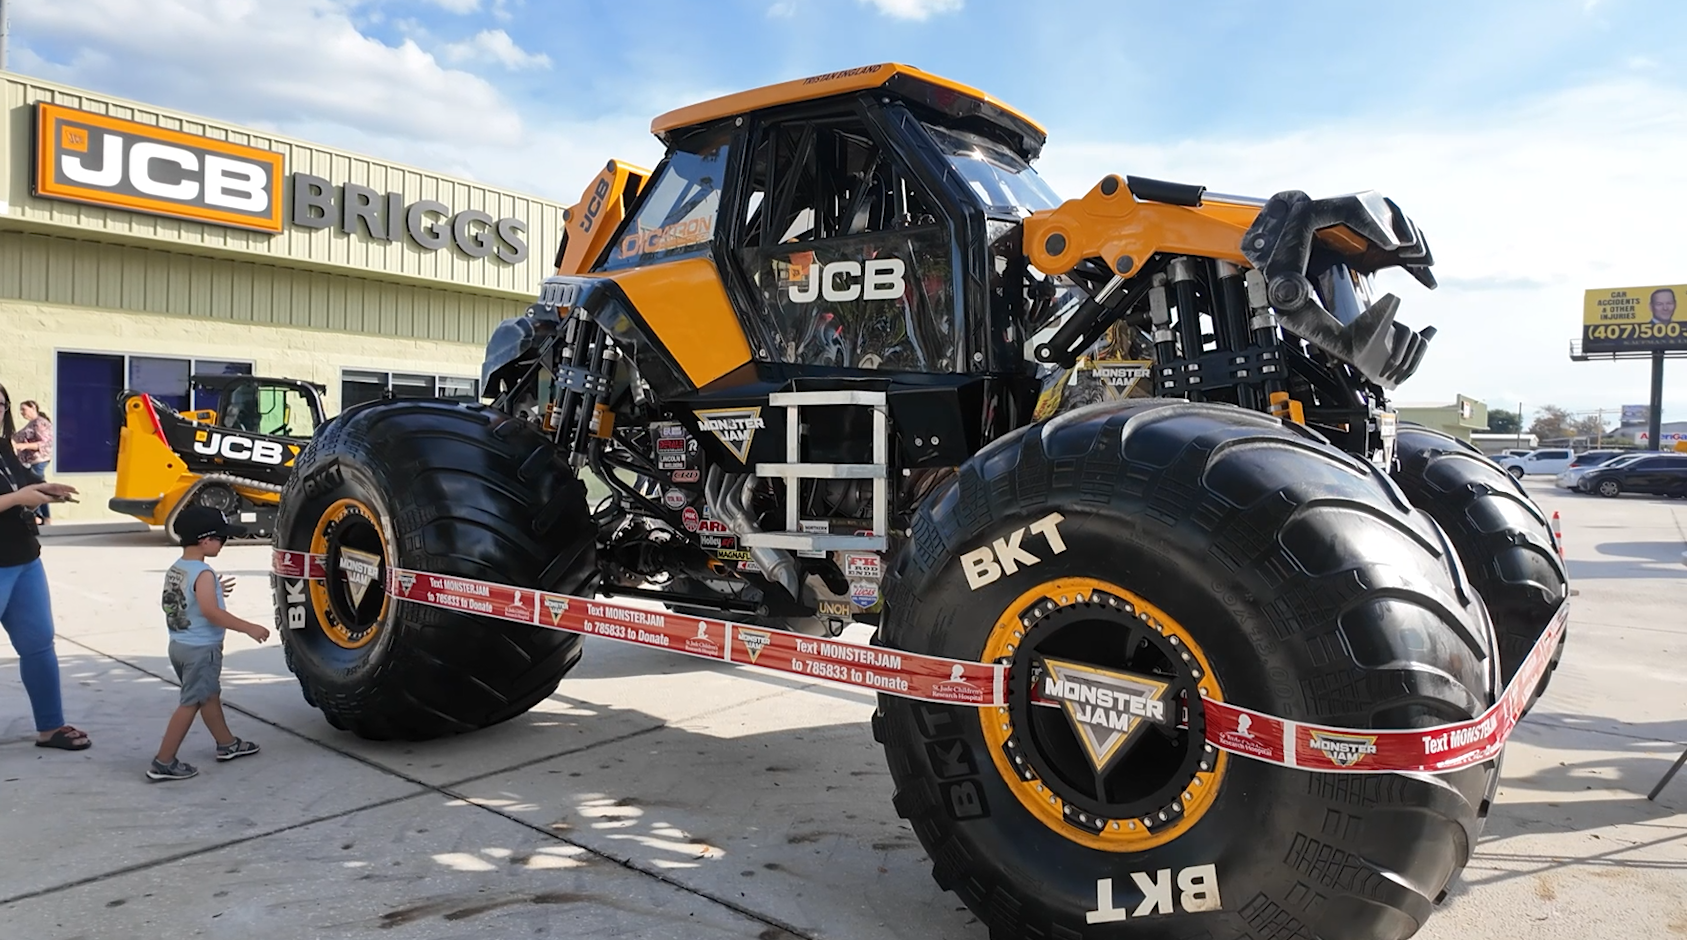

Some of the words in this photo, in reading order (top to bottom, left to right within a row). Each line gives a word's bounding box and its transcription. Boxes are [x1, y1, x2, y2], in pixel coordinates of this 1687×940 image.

[836, 65, 882, 79] ENGLAND
[61, 133, 269, 212] JCB
[579, 177, 610, 233] JCB
[292, 172, 528, 265] BRIGGS
[788, 258, 906, 304] JCB
[1597, 298, 1641, 306] ACCIDENTS
[1610, 305, 1635, 313] OTHER
[1600, 312, 1636, 320] INJURIES
[1092, 368, 1151, 378] MONSTER
[1107, 377, 1134, 386] JAM
[697, 418, 766, 431] MONSTER
[720, 429, 751, 442] JAM
[193, 433, 284, 465] JCB
[303, 461, 344, 496] BKT
[700, 535, 721, 548] Holley
[960, 511, 1067, 591] BKT
[719, 550, 751, 559] MAGNAFL
[850, 557, 878, 566] FK
[340, 557, 379, 580] MONSTER
[349, 573, 370, 586] JAM
[429, 577, 444, 589] Text
[443, 579, 490, 597] MONSTERJAM
[284, 579, 306, 630] BK
[427, 591, 435, 602] to
[460, 597, 468, 606] to
[469, 599, 493, 613] Donate
[819, 602, 850, 616] UNOH
[586, 603, 604, 617] Text
[605, 606, 665, 628] MONSTERJAM
[583, 619, 593, 632] to
[594, 621, 626, 638] 785833
[627, 627, 636, 640] to
[638, 629, 670, 647] Donate
[738, 633, 771, 645] MONSTER
[745, 641, 762, 650] JAM
[795, 638, 818, 655] Text
[820, 643, 901, 670] MONSTERJAM
[791, 658, 804, 672] to
[806, 660, 848, 681] 785833
[850, 669, 863, 682] to
[865, 671, 909, 691] Donate
[932, 690, 958, 699] Research
[958, 693, 983, 702] Hospital
[1045, 676, 1164, 721] MONSTER
[1076, 705, 1129, 732] JAM
[1309, 739, 1377, 754] MONSTER
[1422, 733, 1449, 755] Text
[920, 704, 984, 818] BKT
[1329, 750, 1358, 761] JAM
[1085, 862, 1223, 925] BKT
